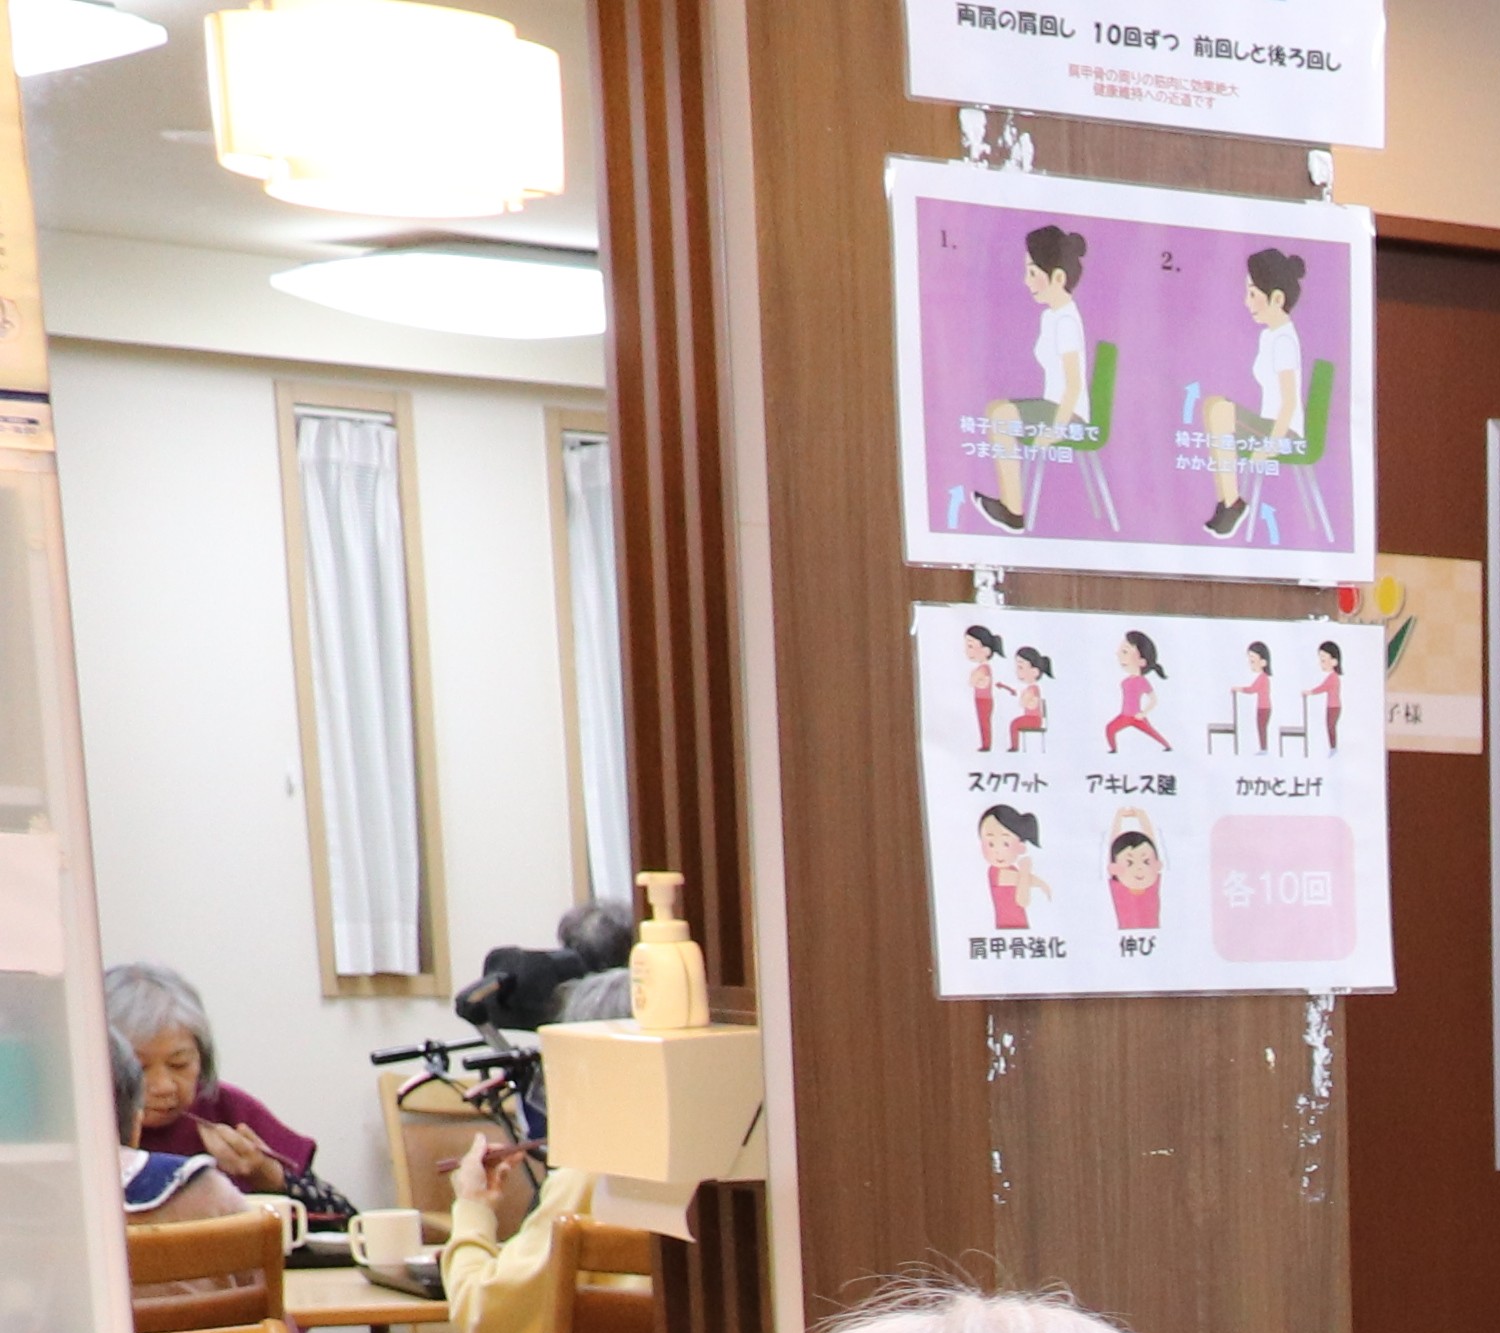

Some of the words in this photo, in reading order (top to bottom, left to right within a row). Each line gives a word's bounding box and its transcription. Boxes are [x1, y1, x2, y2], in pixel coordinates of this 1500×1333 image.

[956, 2, 1076, 38] 両肩の肩回し
[1093, 22, 1180, 51] 10回ずつ
[1193, 35, 1341, 72] 前回しと後ろ回し
[939, 229, 958, 250] 1.
[1161, 250, 1182, 273] 2.
[960, 415, 1100, 441] 椅子に座った状態で
[961, 441, 1074, 464] つま先上げ10回
[1175, 430, 1307, 455] 椅子に座った状態で
[1175, 454, 1280, 476] かかと上げ10回
[968, 772, 1048, 793] スクワット
[1085, 773, 1177, 796] アキレス腱
[1236, 776, 1323, 798] かかと上げ
[1223, 870, 1333, 908] 各10回
[968, 937, 1067, 960] 肩甲骨強化
[1119, 936, 1156, 957] 伸び
